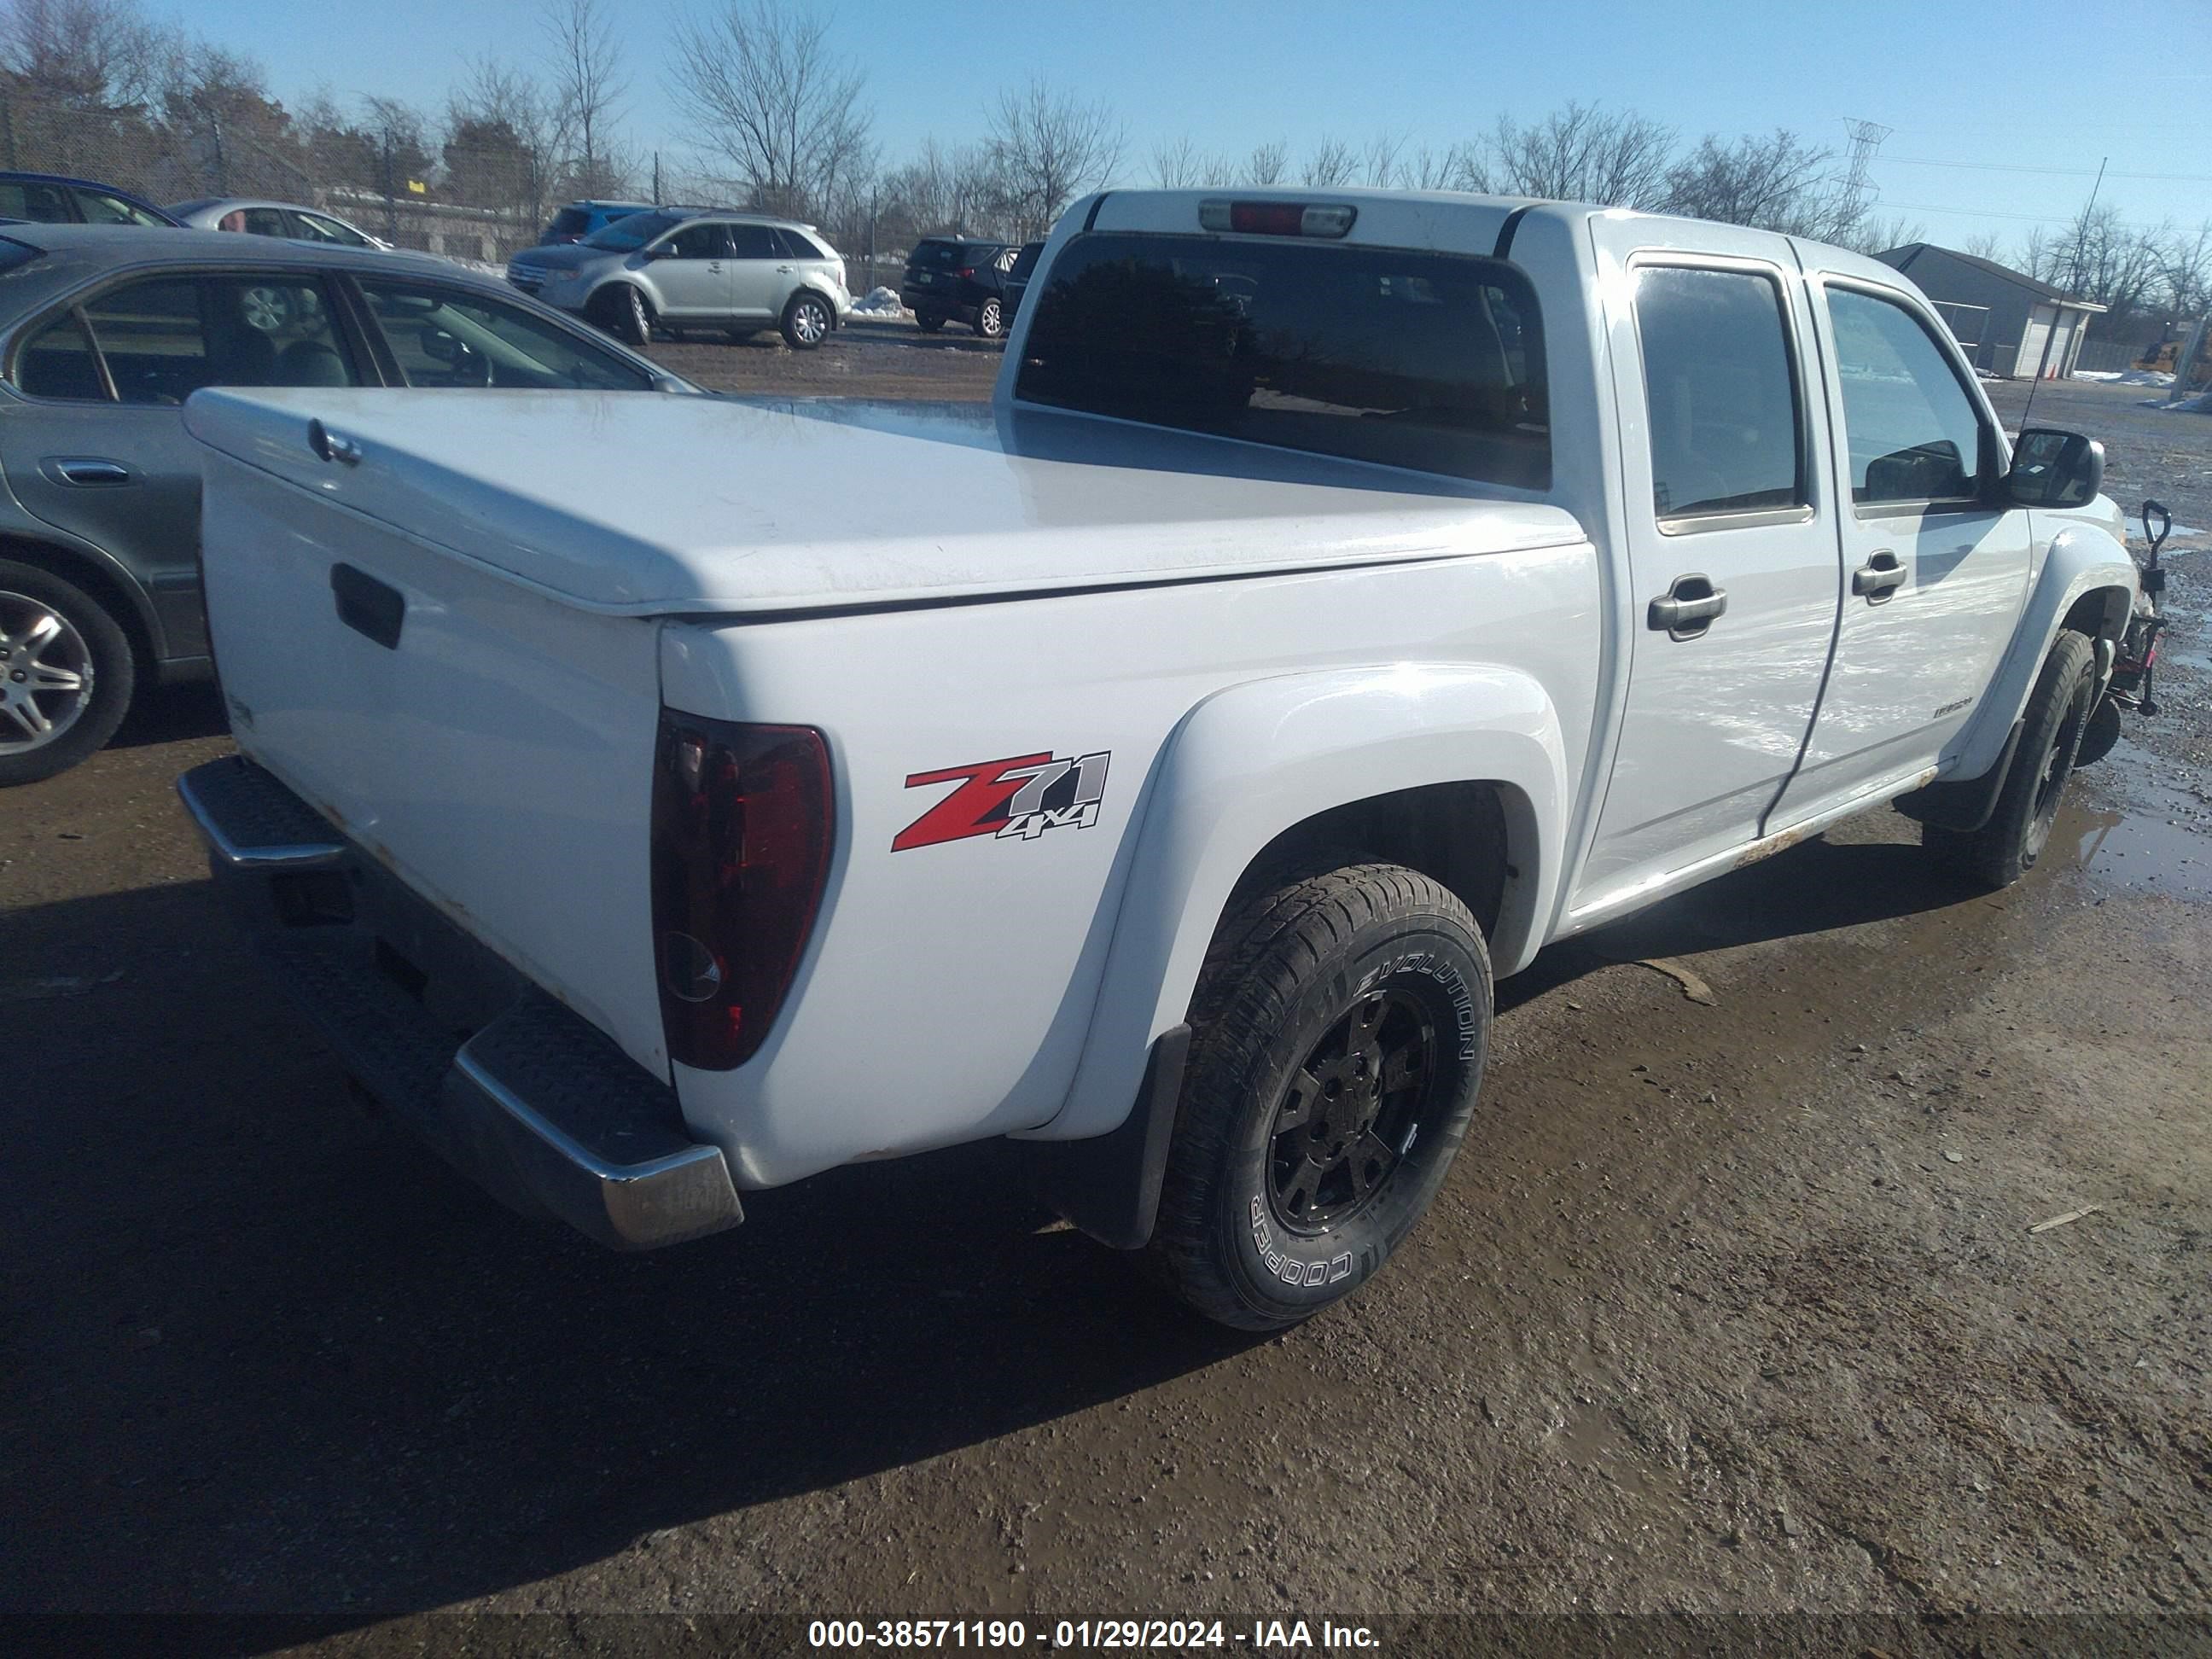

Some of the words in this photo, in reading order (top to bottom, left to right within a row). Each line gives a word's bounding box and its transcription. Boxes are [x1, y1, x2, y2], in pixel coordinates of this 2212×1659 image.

[890, 749, 1112, 853] Z71
[1352, 952, 1476, 1062] EVOLUTION
[1249, 1191, 1353, 1288] COOPER
